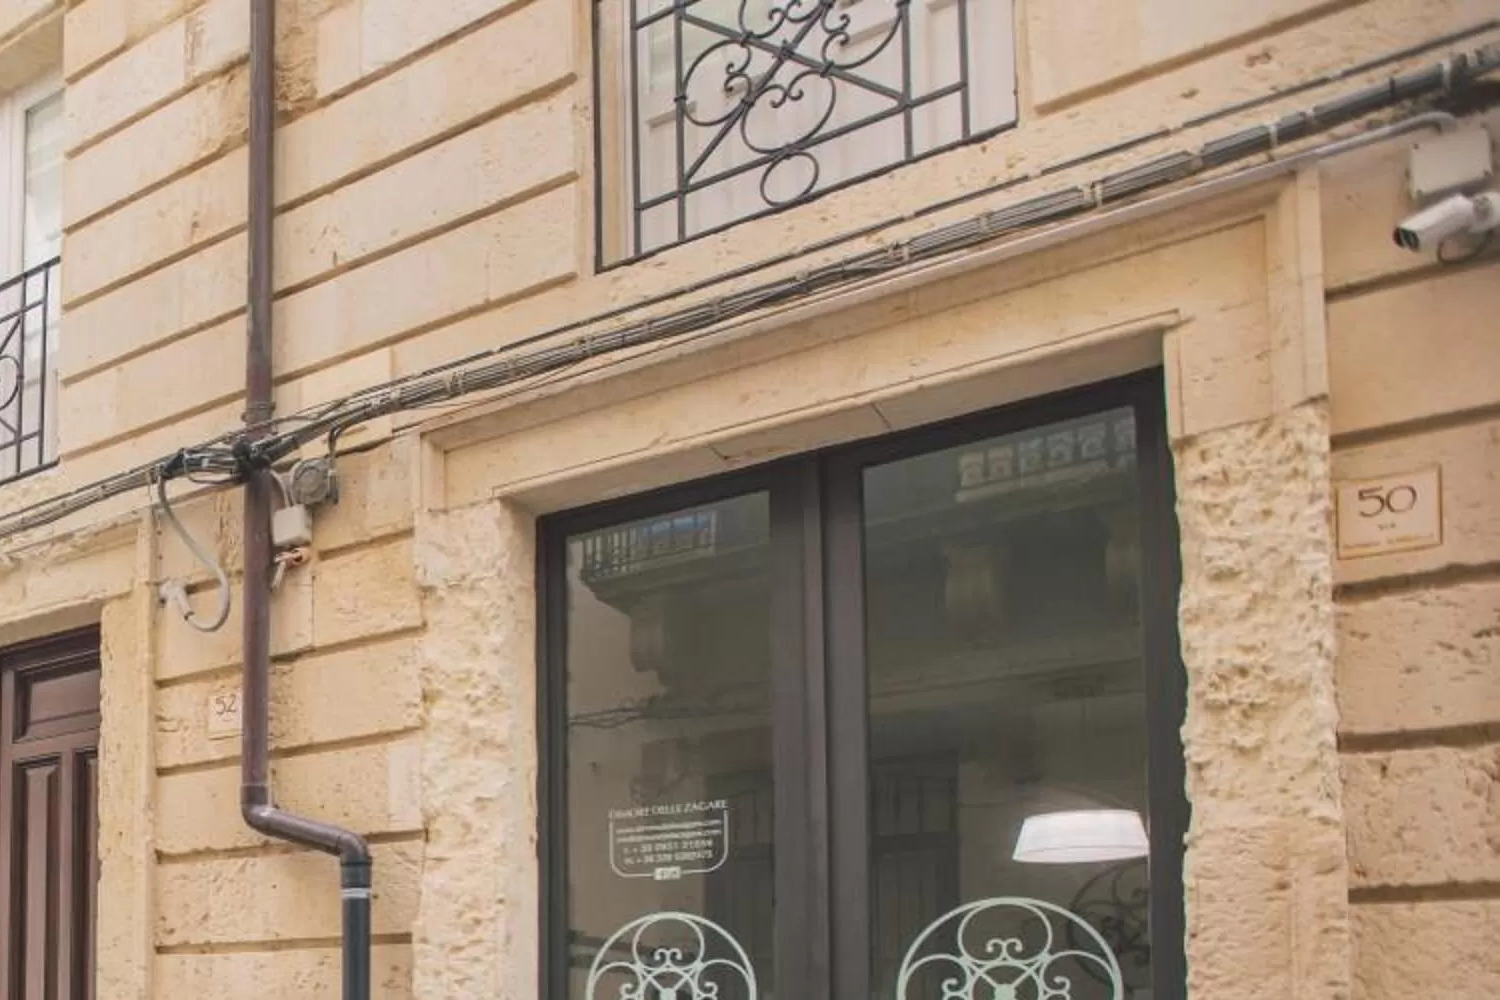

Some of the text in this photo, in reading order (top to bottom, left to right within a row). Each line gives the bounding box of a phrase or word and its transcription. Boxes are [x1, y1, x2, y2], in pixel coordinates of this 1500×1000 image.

[1357, 484, 1418, 518] 50
[215, 693, 237, 716] 52
[683, 799, 729, 814] ZAGARE
